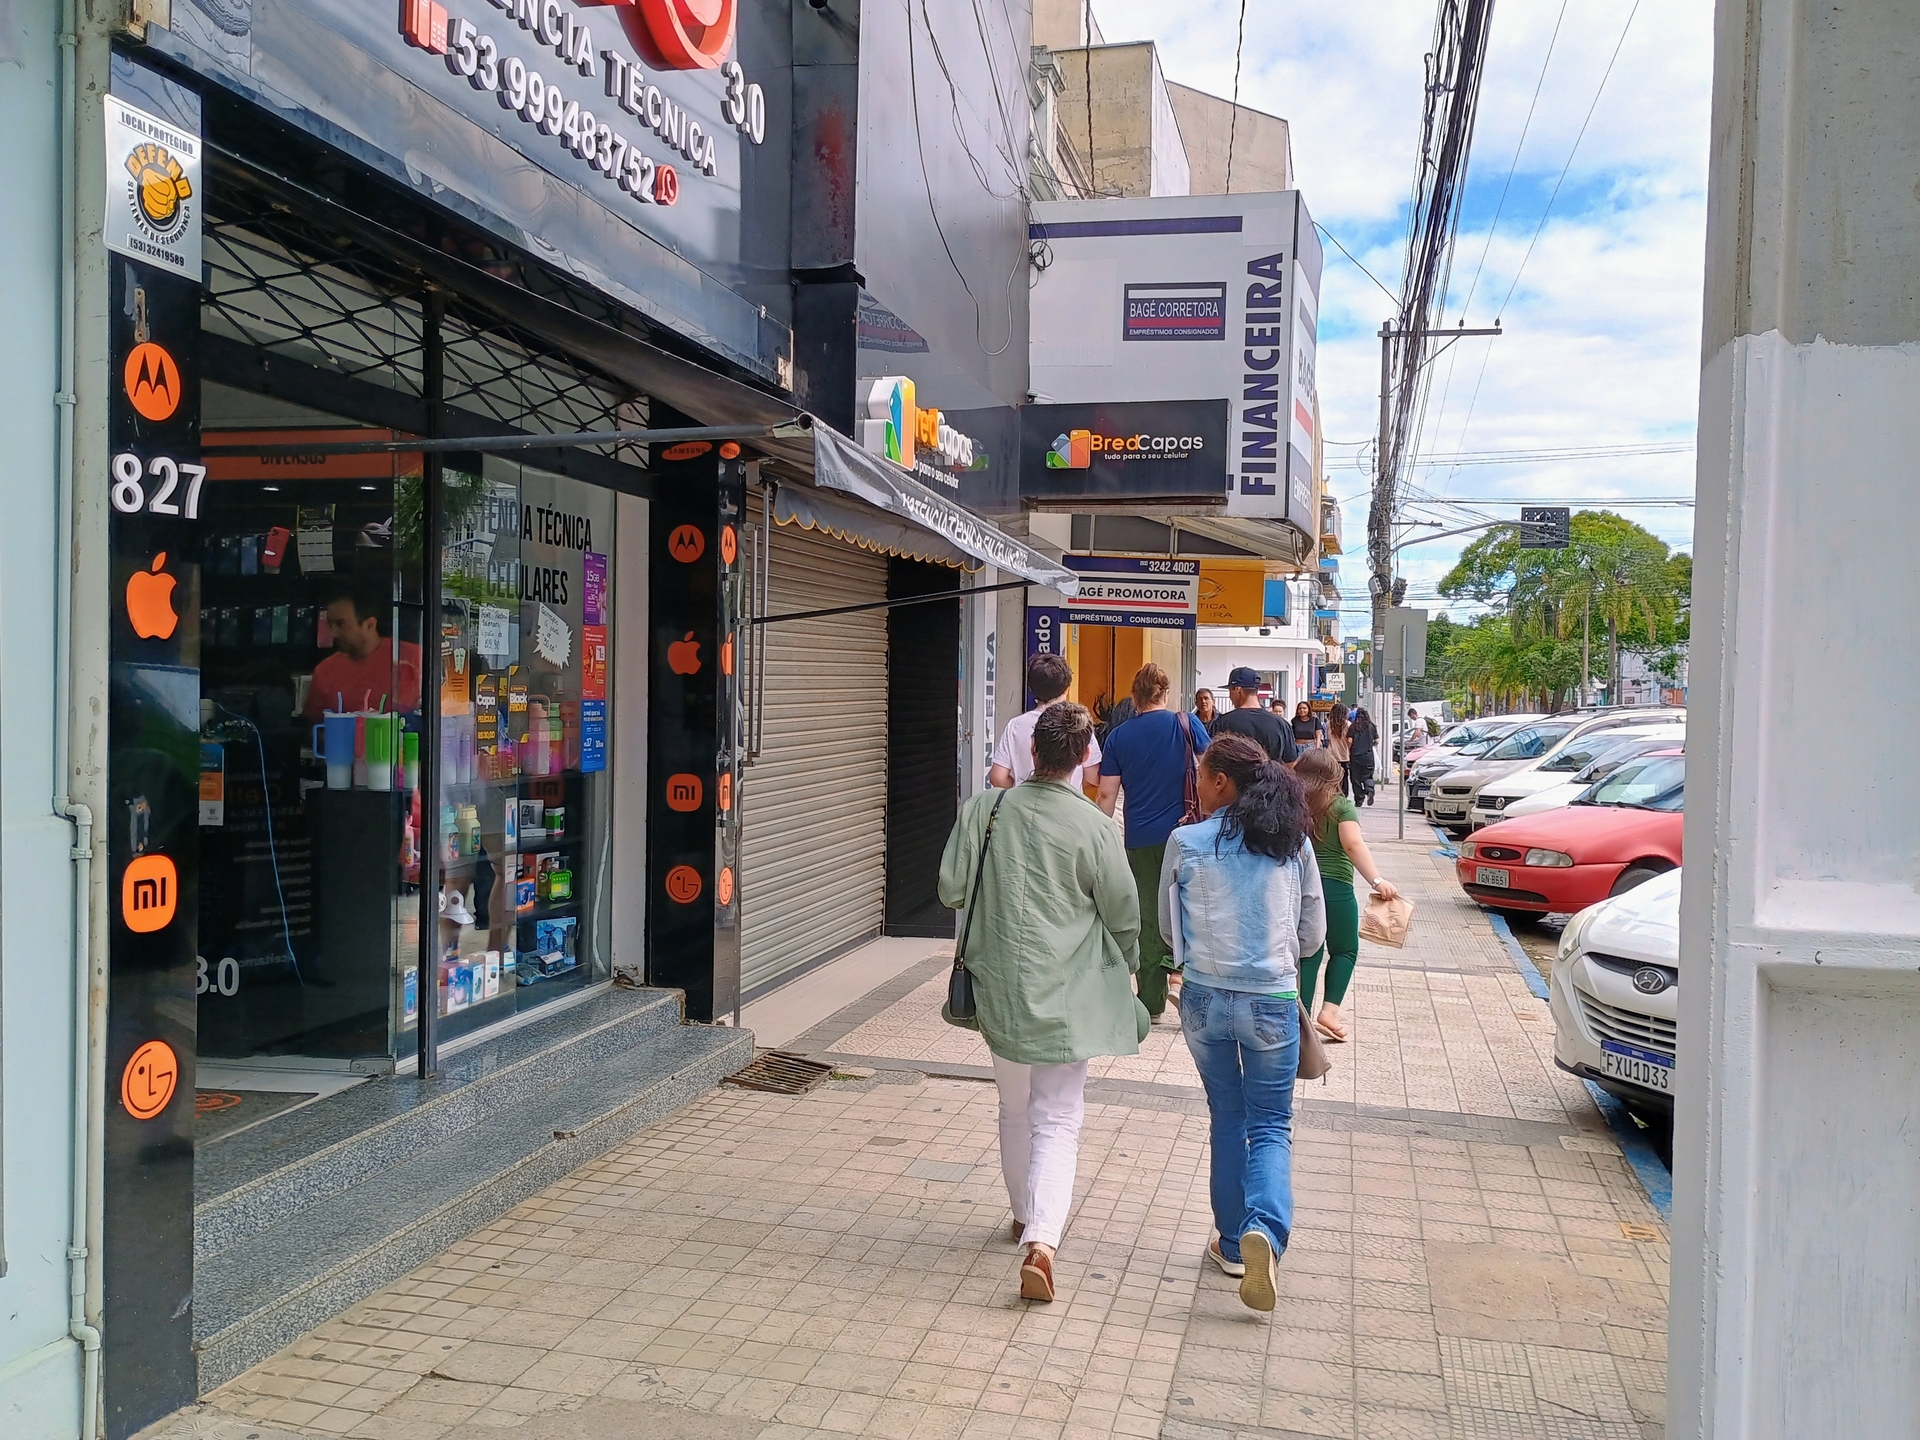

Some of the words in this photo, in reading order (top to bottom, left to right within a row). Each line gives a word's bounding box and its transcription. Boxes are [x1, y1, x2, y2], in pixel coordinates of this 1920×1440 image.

[445, 18, 498, 92] 53
[497, 57, 655, 203] 999483752
[601, 49, 718, 178] TÉCNICA
[721, 60, 766, 145] 3.0
[121, 112, 147, 134] LOCAL
[148, 123, 194, 155] PROTEGIDO
[124, 142, 192, 200] DEFEND
[127, 180, 149, 239] SISTEMAS
[160, 205, 191, 246] SEGURANÇA
[1130, 299, 1156, 318] BAGÉ
[1158, 302, 1219, 317] CORRETORA
[1129, 327, 1173, 336] EMPRÉSTIMOS
[1173, 328, 1219, 336] CONSIGNADOS
[1240, 252, 1284, 496] FINANCEIRA
[915, 405, 973, 468] redCapas
[1090, 433, 1204, 453] BredCapas
[1122, 453, 1140, 461] para
[111, 452, 207, 520] 827
[537, 502, 593, 553] TÉCNICA
[487, 556, 569, 606] CELULARES
[1149, 560, 1171, 572] 3242
[1172, 561, 1195, 573] 4002
[1079, 585, 1104, 597] AGÉ
[1107, 589, 1186, 600] PROMOTORA
[1069, 613, 1123, 622] EMPRÉSTIMOS
[1129, 616, 1185, 625] CONSIGNADOS
[477, 694, 496, 710] Capa
[509, 693, 528, 704] Black
[509, 703, 528, 712] FRIDAY
[1606, 1053, 1668, 1089] FXU1D33
